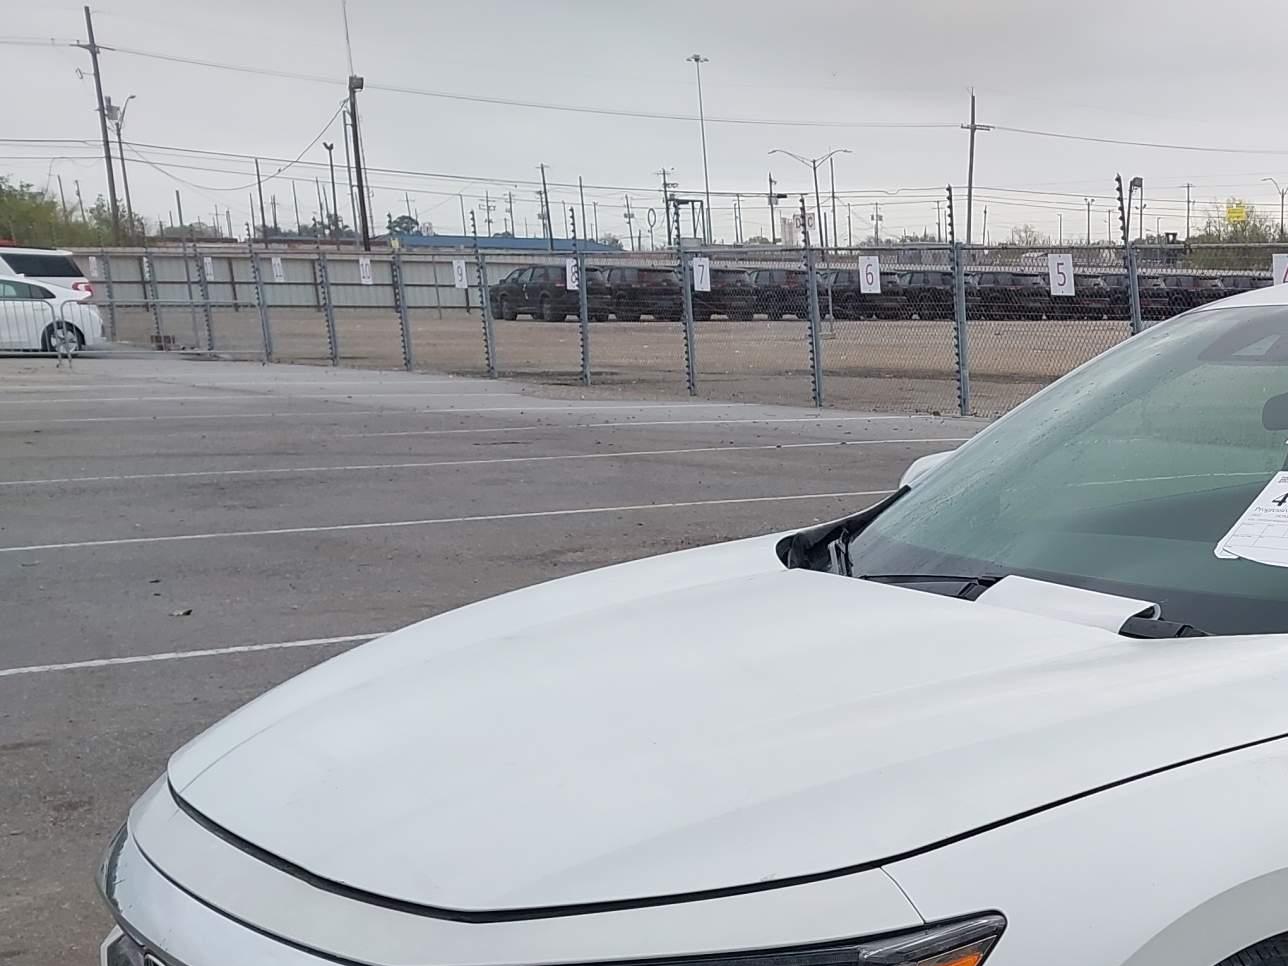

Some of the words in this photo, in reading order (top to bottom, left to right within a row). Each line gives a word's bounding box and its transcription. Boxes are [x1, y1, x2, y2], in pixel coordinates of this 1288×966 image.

[697, 264, 706, 284] 7
[865, 263, 875, 286] 6
[1056, 262, 1067, 287] 5
